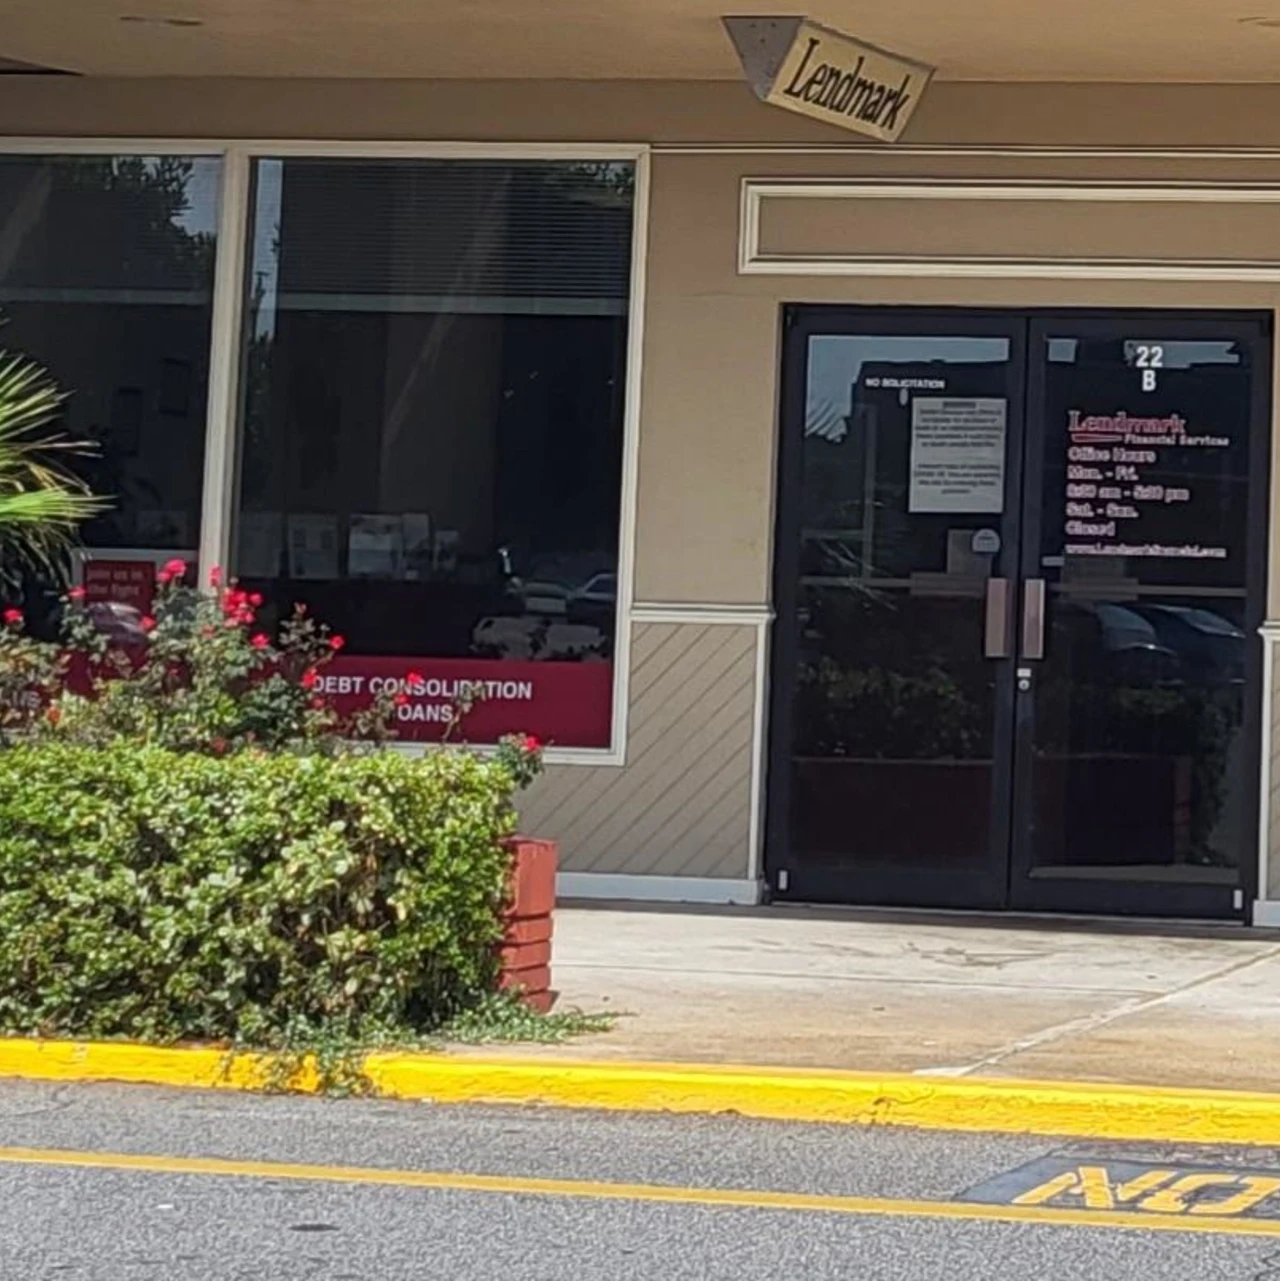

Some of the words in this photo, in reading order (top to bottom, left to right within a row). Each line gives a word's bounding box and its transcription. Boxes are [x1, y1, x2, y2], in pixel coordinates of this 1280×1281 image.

[784, 37, 910, 131] Lendmark
[1135, 346, 1164, 368] 22
[1141, 369, 1157, 391] B
[1068, 410, 1186, 433] Lendmark
[1179, 436, 1229, 446] Services
[312, 675, 365, 694] DEBT
[388, 704, 453, 723] OANS
